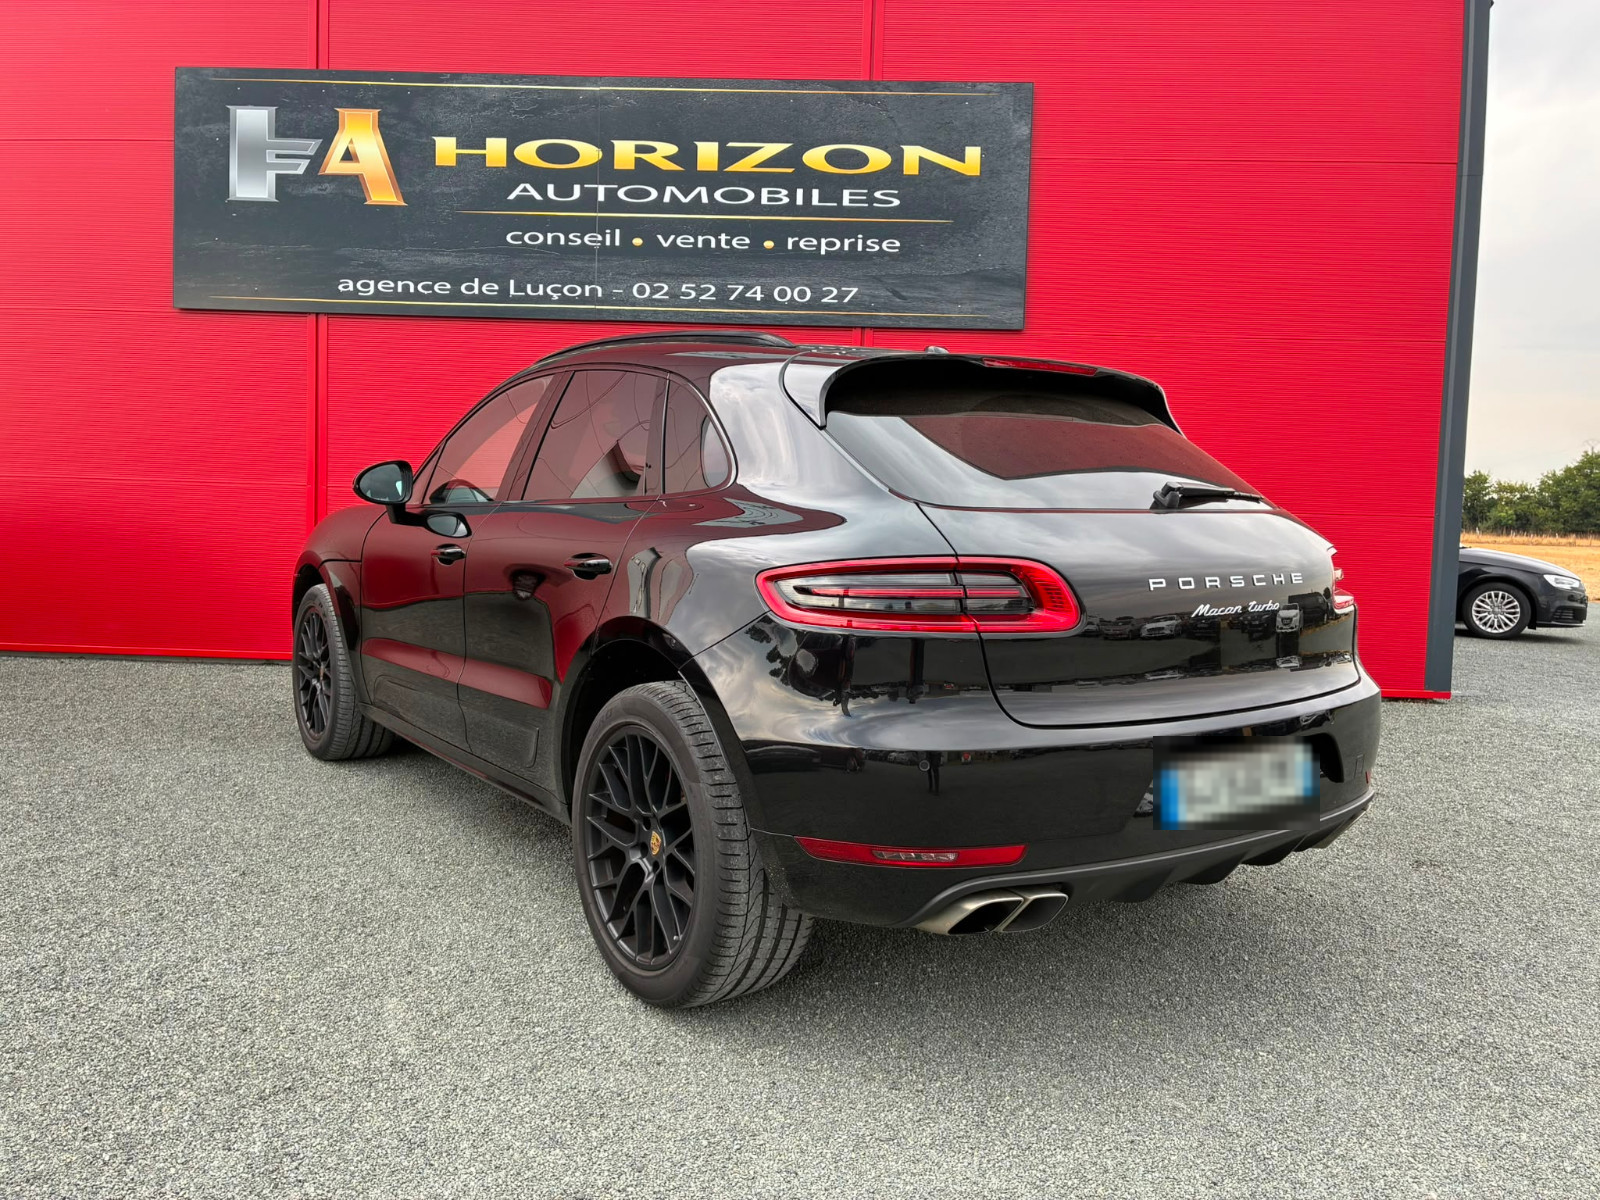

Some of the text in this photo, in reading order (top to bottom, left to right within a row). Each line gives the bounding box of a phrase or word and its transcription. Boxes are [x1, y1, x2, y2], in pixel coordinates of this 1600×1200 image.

[432, 136, 982, 177] HORIZON
[507, 183, 902, 208] AUTOMOBILES
[506, 228, 901, 255] conseil vente reprise
[338, 279, 451, 296] agence
[460, 277, 499, 295] de
[508, 279, 602, 300] Luçon
[632, 283, 670, 299] 02
[679, 284, 716, 300] 52
[727, 285, 765, 301] 74
[773, 286, 811, 302] 00
[821, 287, 859, 303] 27
[1149, 573, 1303, 591] PORSCHE
[1191, 600, 1281, 618] Macan turbo
